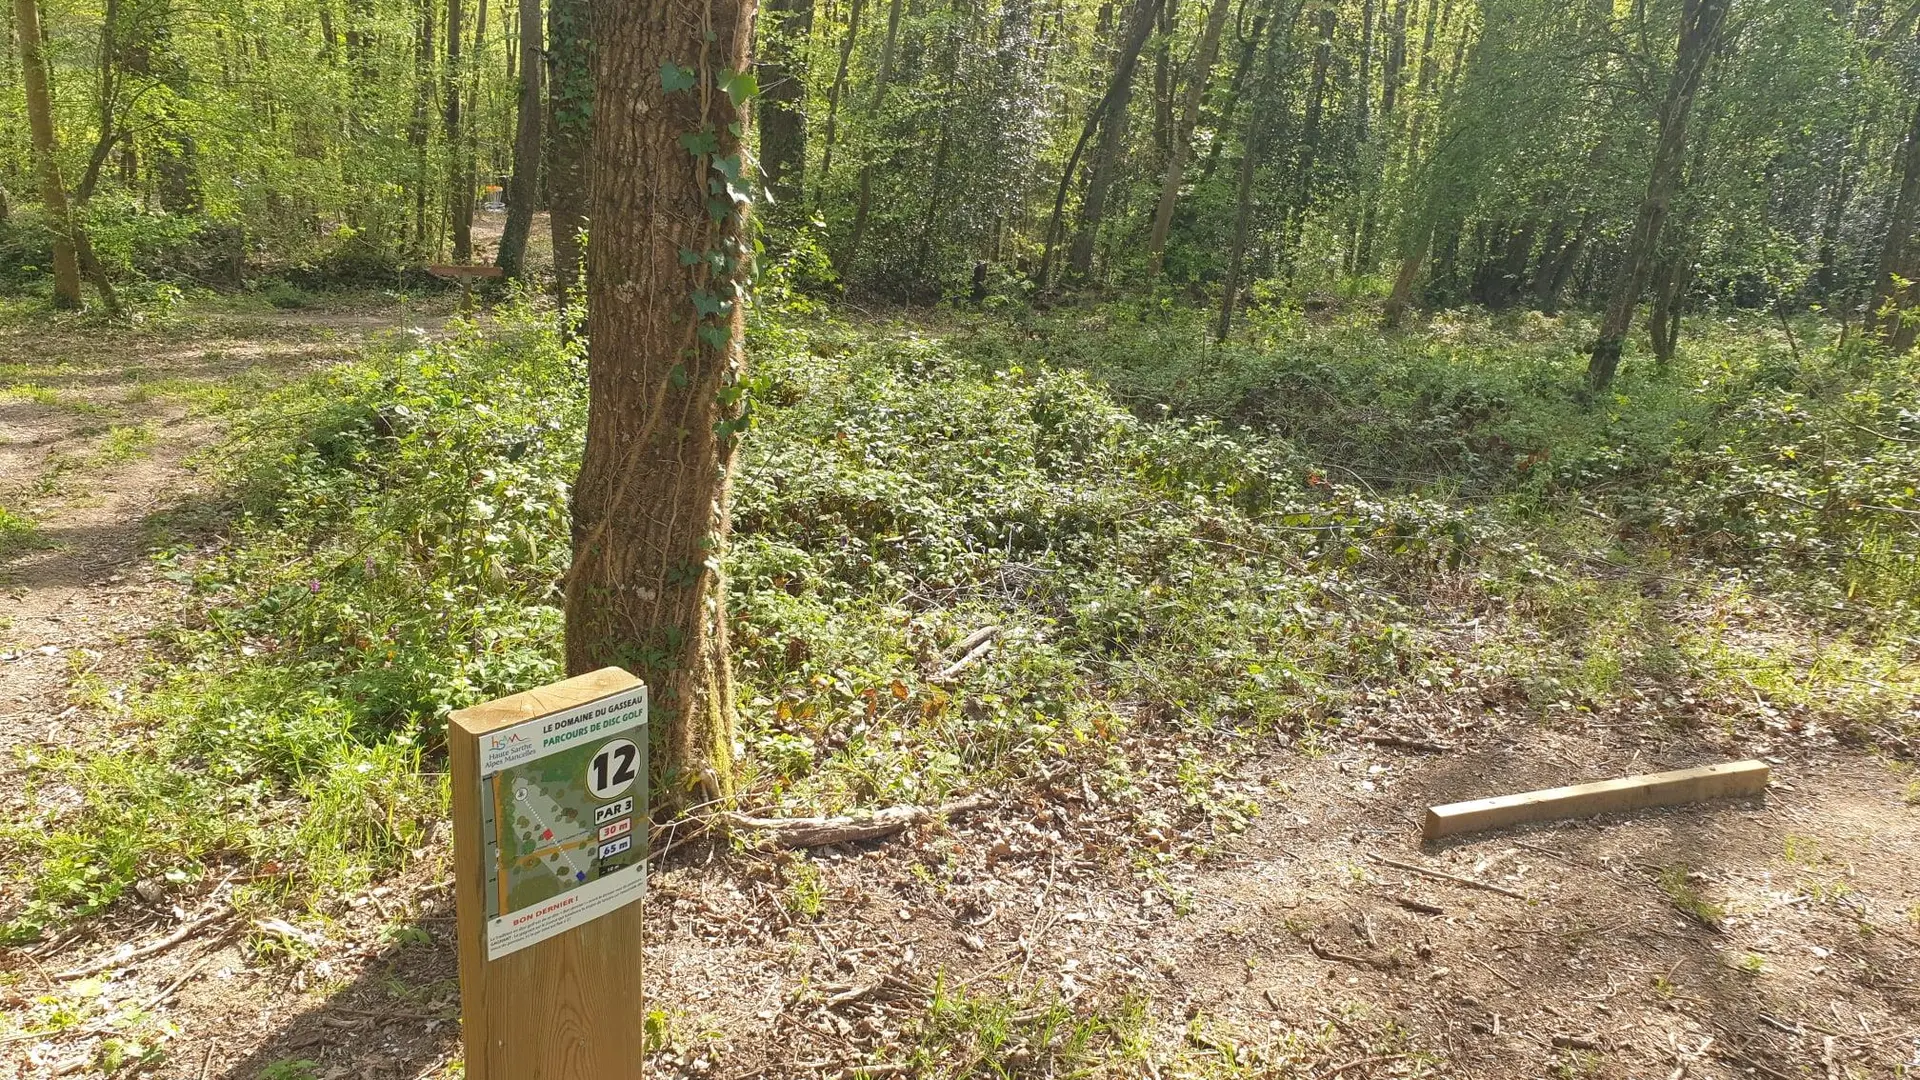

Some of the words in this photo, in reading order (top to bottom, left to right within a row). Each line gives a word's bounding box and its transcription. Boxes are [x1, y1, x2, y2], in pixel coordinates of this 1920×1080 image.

[543, 725, 553, 734] LE
[554, 713, 594, 731] DOMAINE
[595, 708, 607, 718] DU
[608, 695, 643, 713] GASSEAU
[543, 727, 588, 748] PARCOURS
[590, 723, 601, 733] DE
[602, 715, 621, 729] DISC
[622, 708, 644, 722] GOLF
[489, 749, 510, 761] Haute
[510, 742, 533, 755] Sarthe
[593, 744, 636, 792] 12
[596, 803, 622, 821] PAR
[624, 800, 632, 811] 3
[603, 825, 617, 837] 30
[619, 822, 628, 831] m
[603, 843, 616, 856] 65
[619, 840, 628, 850] m
[513, 913, 534, 926] BON
[535, 897, 574, 917] DERNIER
